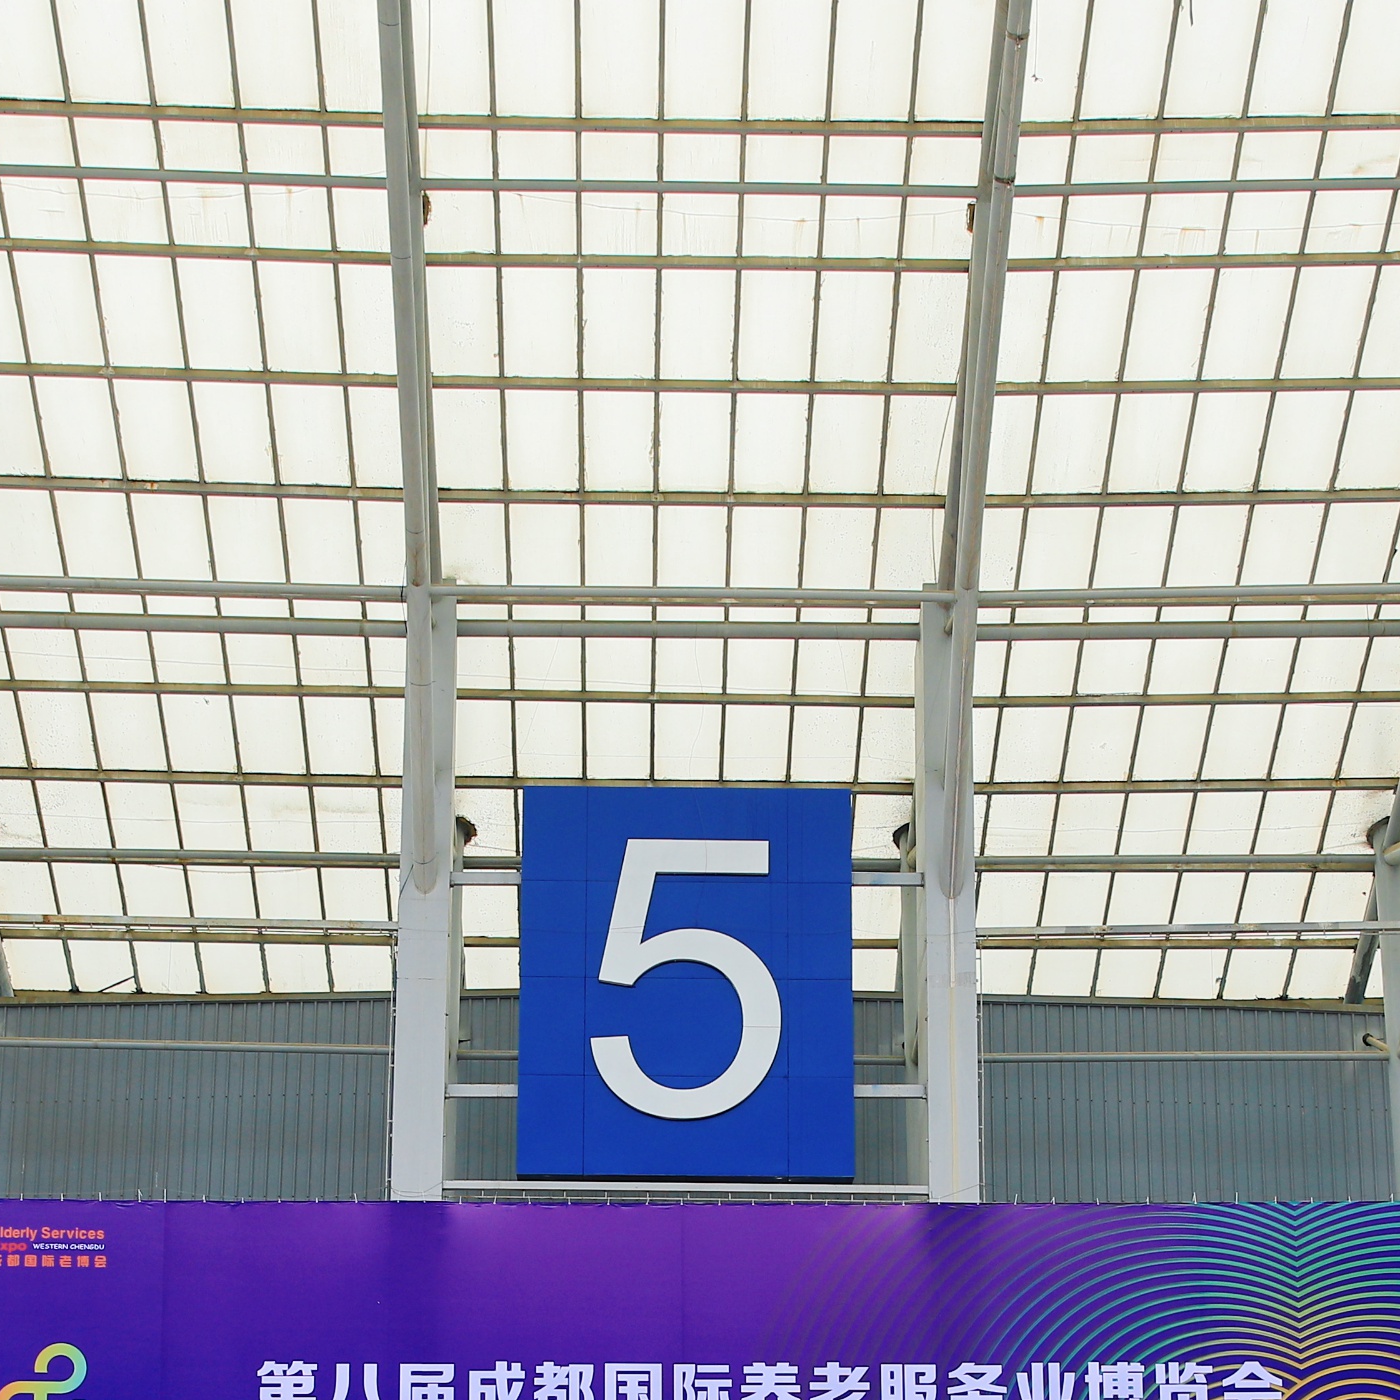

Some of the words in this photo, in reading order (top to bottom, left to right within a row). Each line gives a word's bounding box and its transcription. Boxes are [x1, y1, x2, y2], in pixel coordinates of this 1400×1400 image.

[590, 838, 783, 1120] 5
[41, 1226, 105, 1240] Services
[33, 1243, 69, 1251] WESTERN
[70, 1243, 105, 1251] CHENGDU
